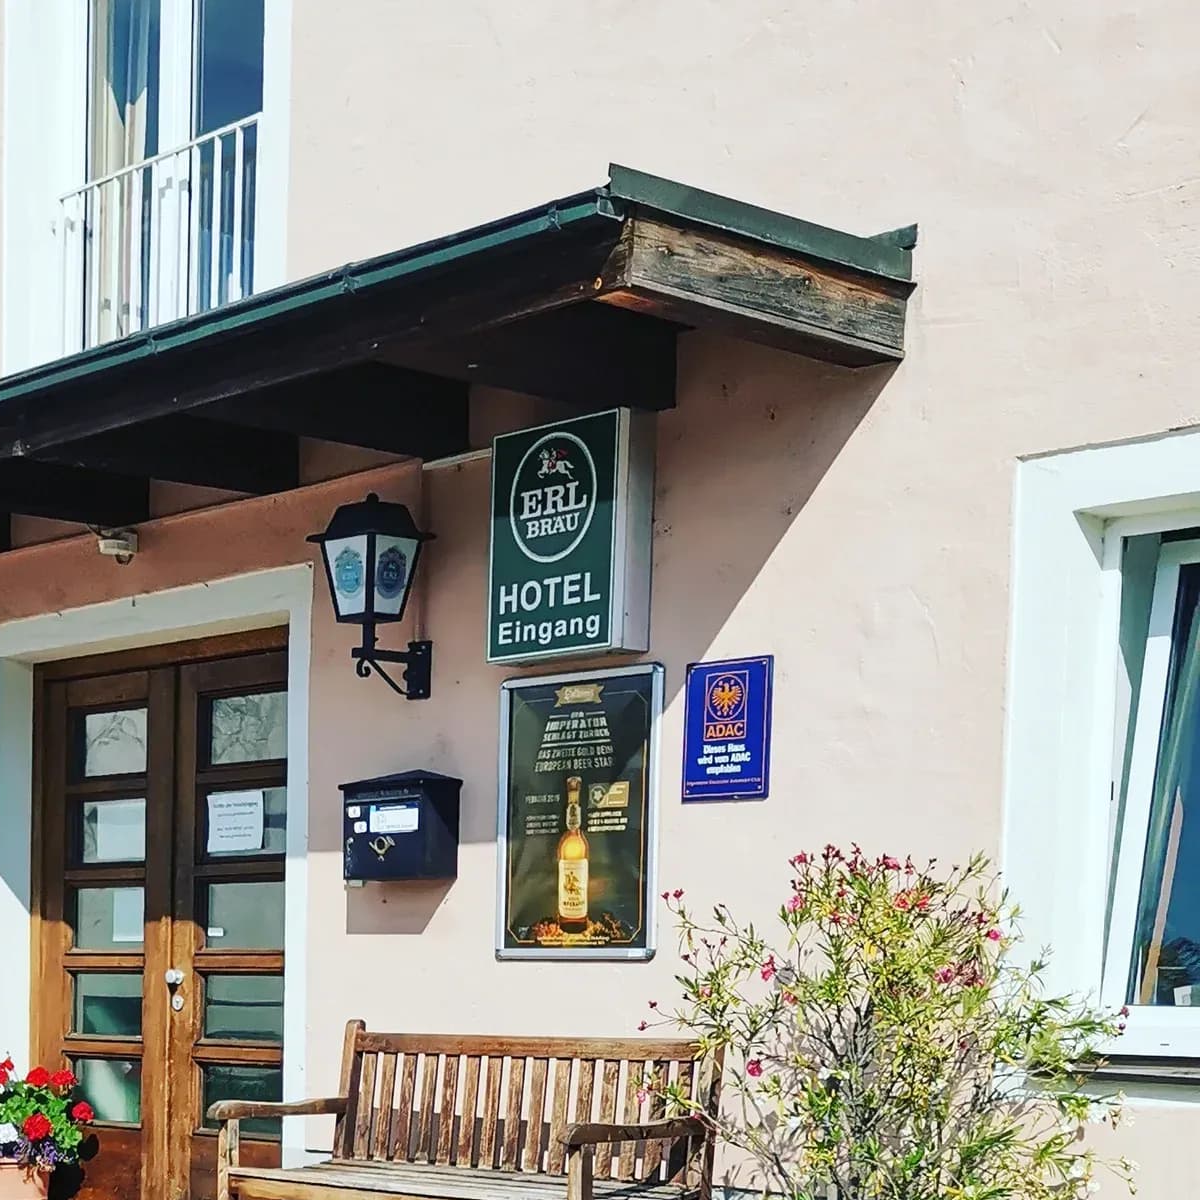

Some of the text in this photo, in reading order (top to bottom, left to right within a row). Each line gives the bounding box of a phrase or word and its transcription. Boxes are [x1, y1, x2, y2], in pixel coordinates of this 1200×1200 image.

[520, 481, 587, 520] ERL
[526, 512, 580, 539] BRÄU
[499, 572, 601, 615] HOTEL
[498, 614, 601, 646] Eingang
[545, 717, 608, 732] IMPERATOR
[706, 723, 744, 738] ADAC
[577, 746, 595, 756] GOLD
[703, 744, 726, 755] Dieses
[534, 760, 572, 773] EUROPEAN
[573, 758, 593, 770] BEER
[697, 755, 714, 765] wird
[730, 752, 751, 762] ADAC
